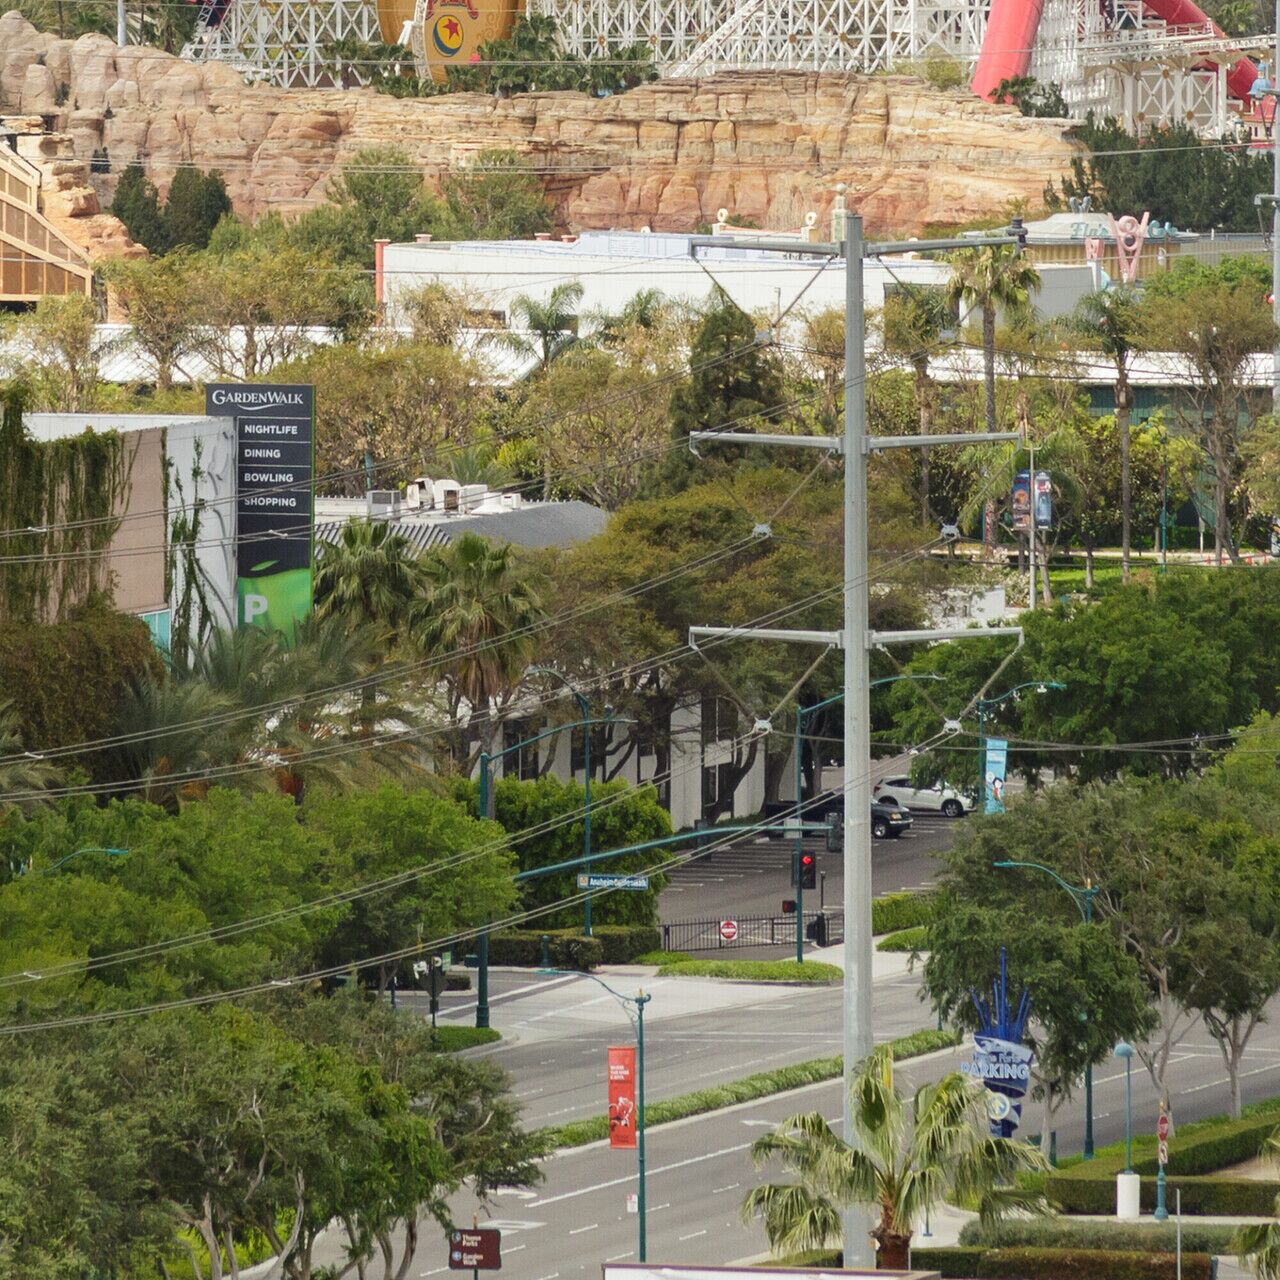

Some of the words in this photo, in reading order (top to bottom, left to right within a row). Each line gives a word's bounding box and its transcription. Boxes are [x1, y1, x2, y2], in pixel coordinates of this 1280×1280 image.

[244, 424, 298, 435] NIGHTLIFE
[244, 448, 281, 459] DINING
[244, 473, 294, 483] BOWLING
[244, 497, 297, 507] SHOPPING
[244, 593, 268, 624] P
[960, 1061, 1029, 1080] PARKING
